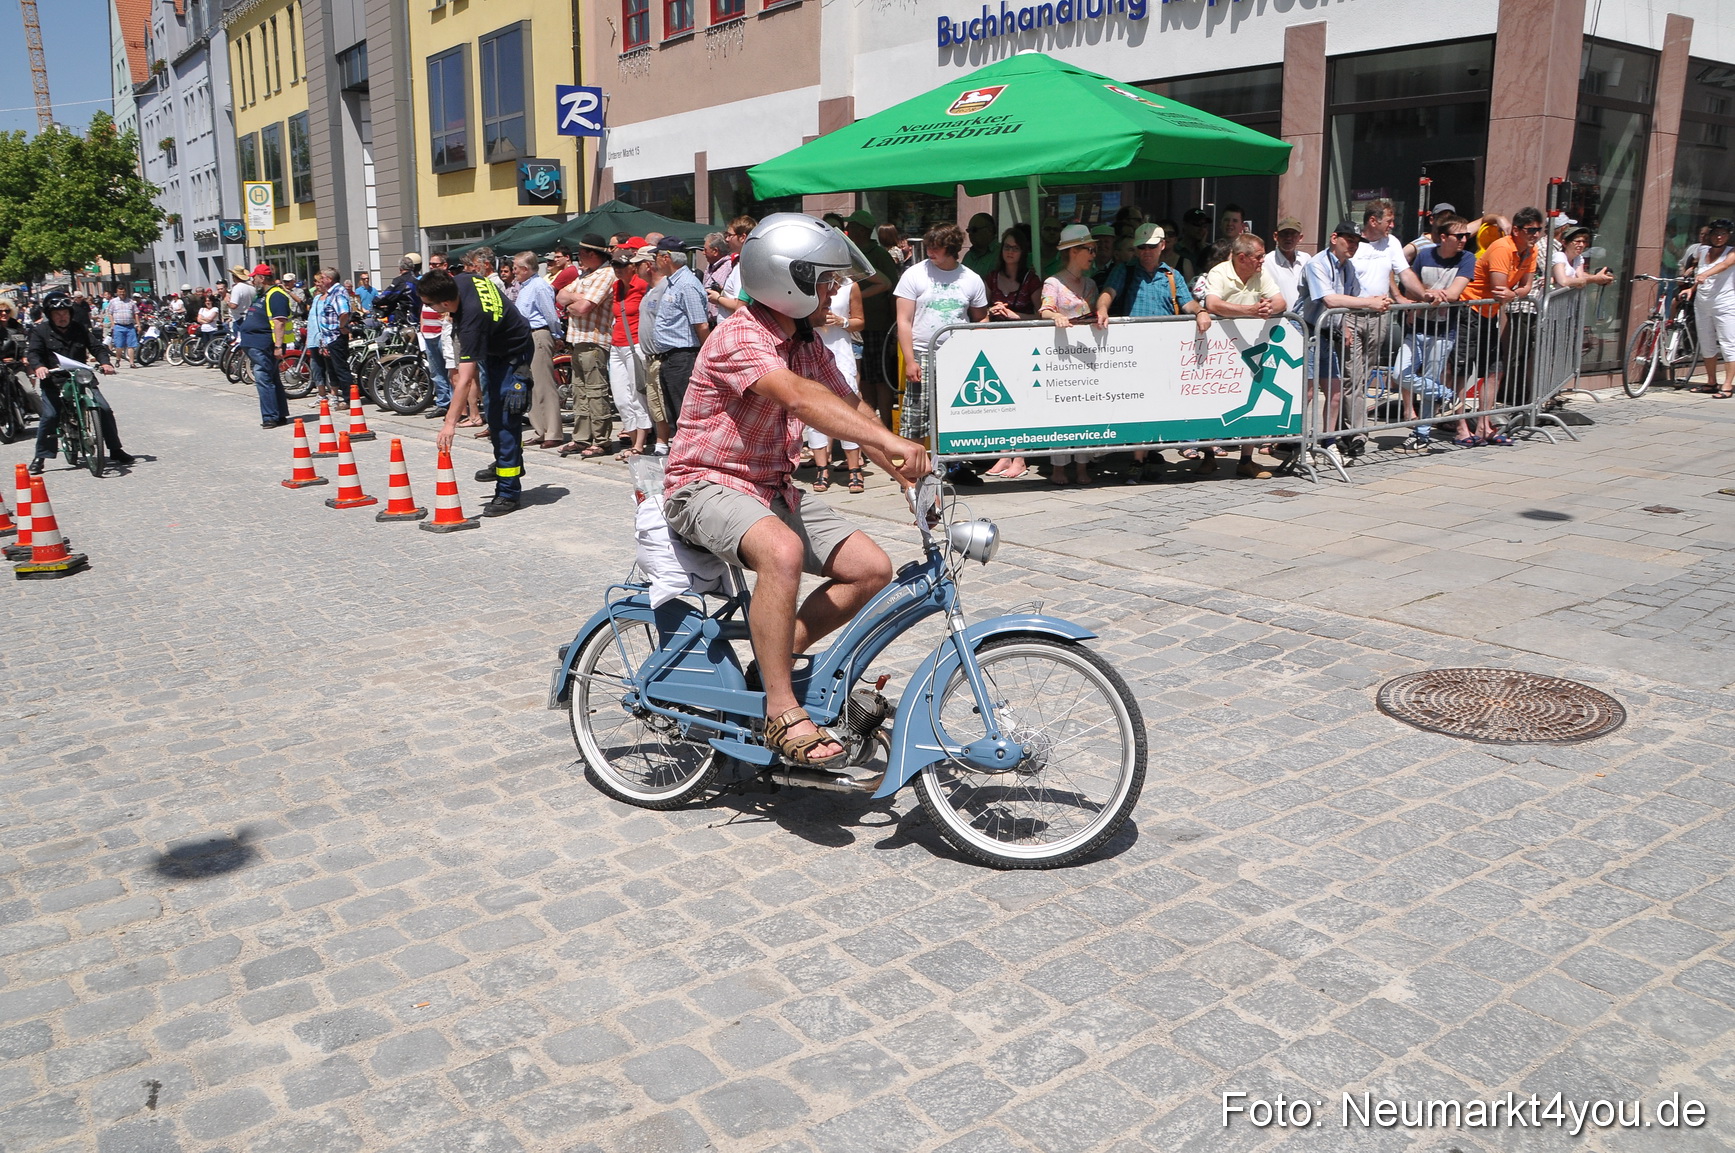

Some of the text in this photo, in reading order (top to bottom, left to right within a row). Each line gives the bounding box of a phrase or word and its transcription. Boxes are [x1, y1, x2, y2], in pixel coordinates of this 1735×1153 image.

[938, 0, 1148, 48] Buchhandlung
[896, 114, 1014, 134] Neumarkter
[860, 123, 1024, 149] Lammsbräu
[535, 171, 550, 191] G2
[254, 189, 263, 201] H
[472, 276, 495, 313] THW
[1045, 344, 1134, 355] Gebäudereinigung
[1206, 337, 1238, 350] UNS
[1045, 360, 1138, 371] Hausmeisterdienste
[1046, 377, 1099, 387] Mietservice
[1054, 391, 1145, 402] Event-Leit-Systeme
[950, 429, 1117, 448] www.jura-gebaeudeservice.de
